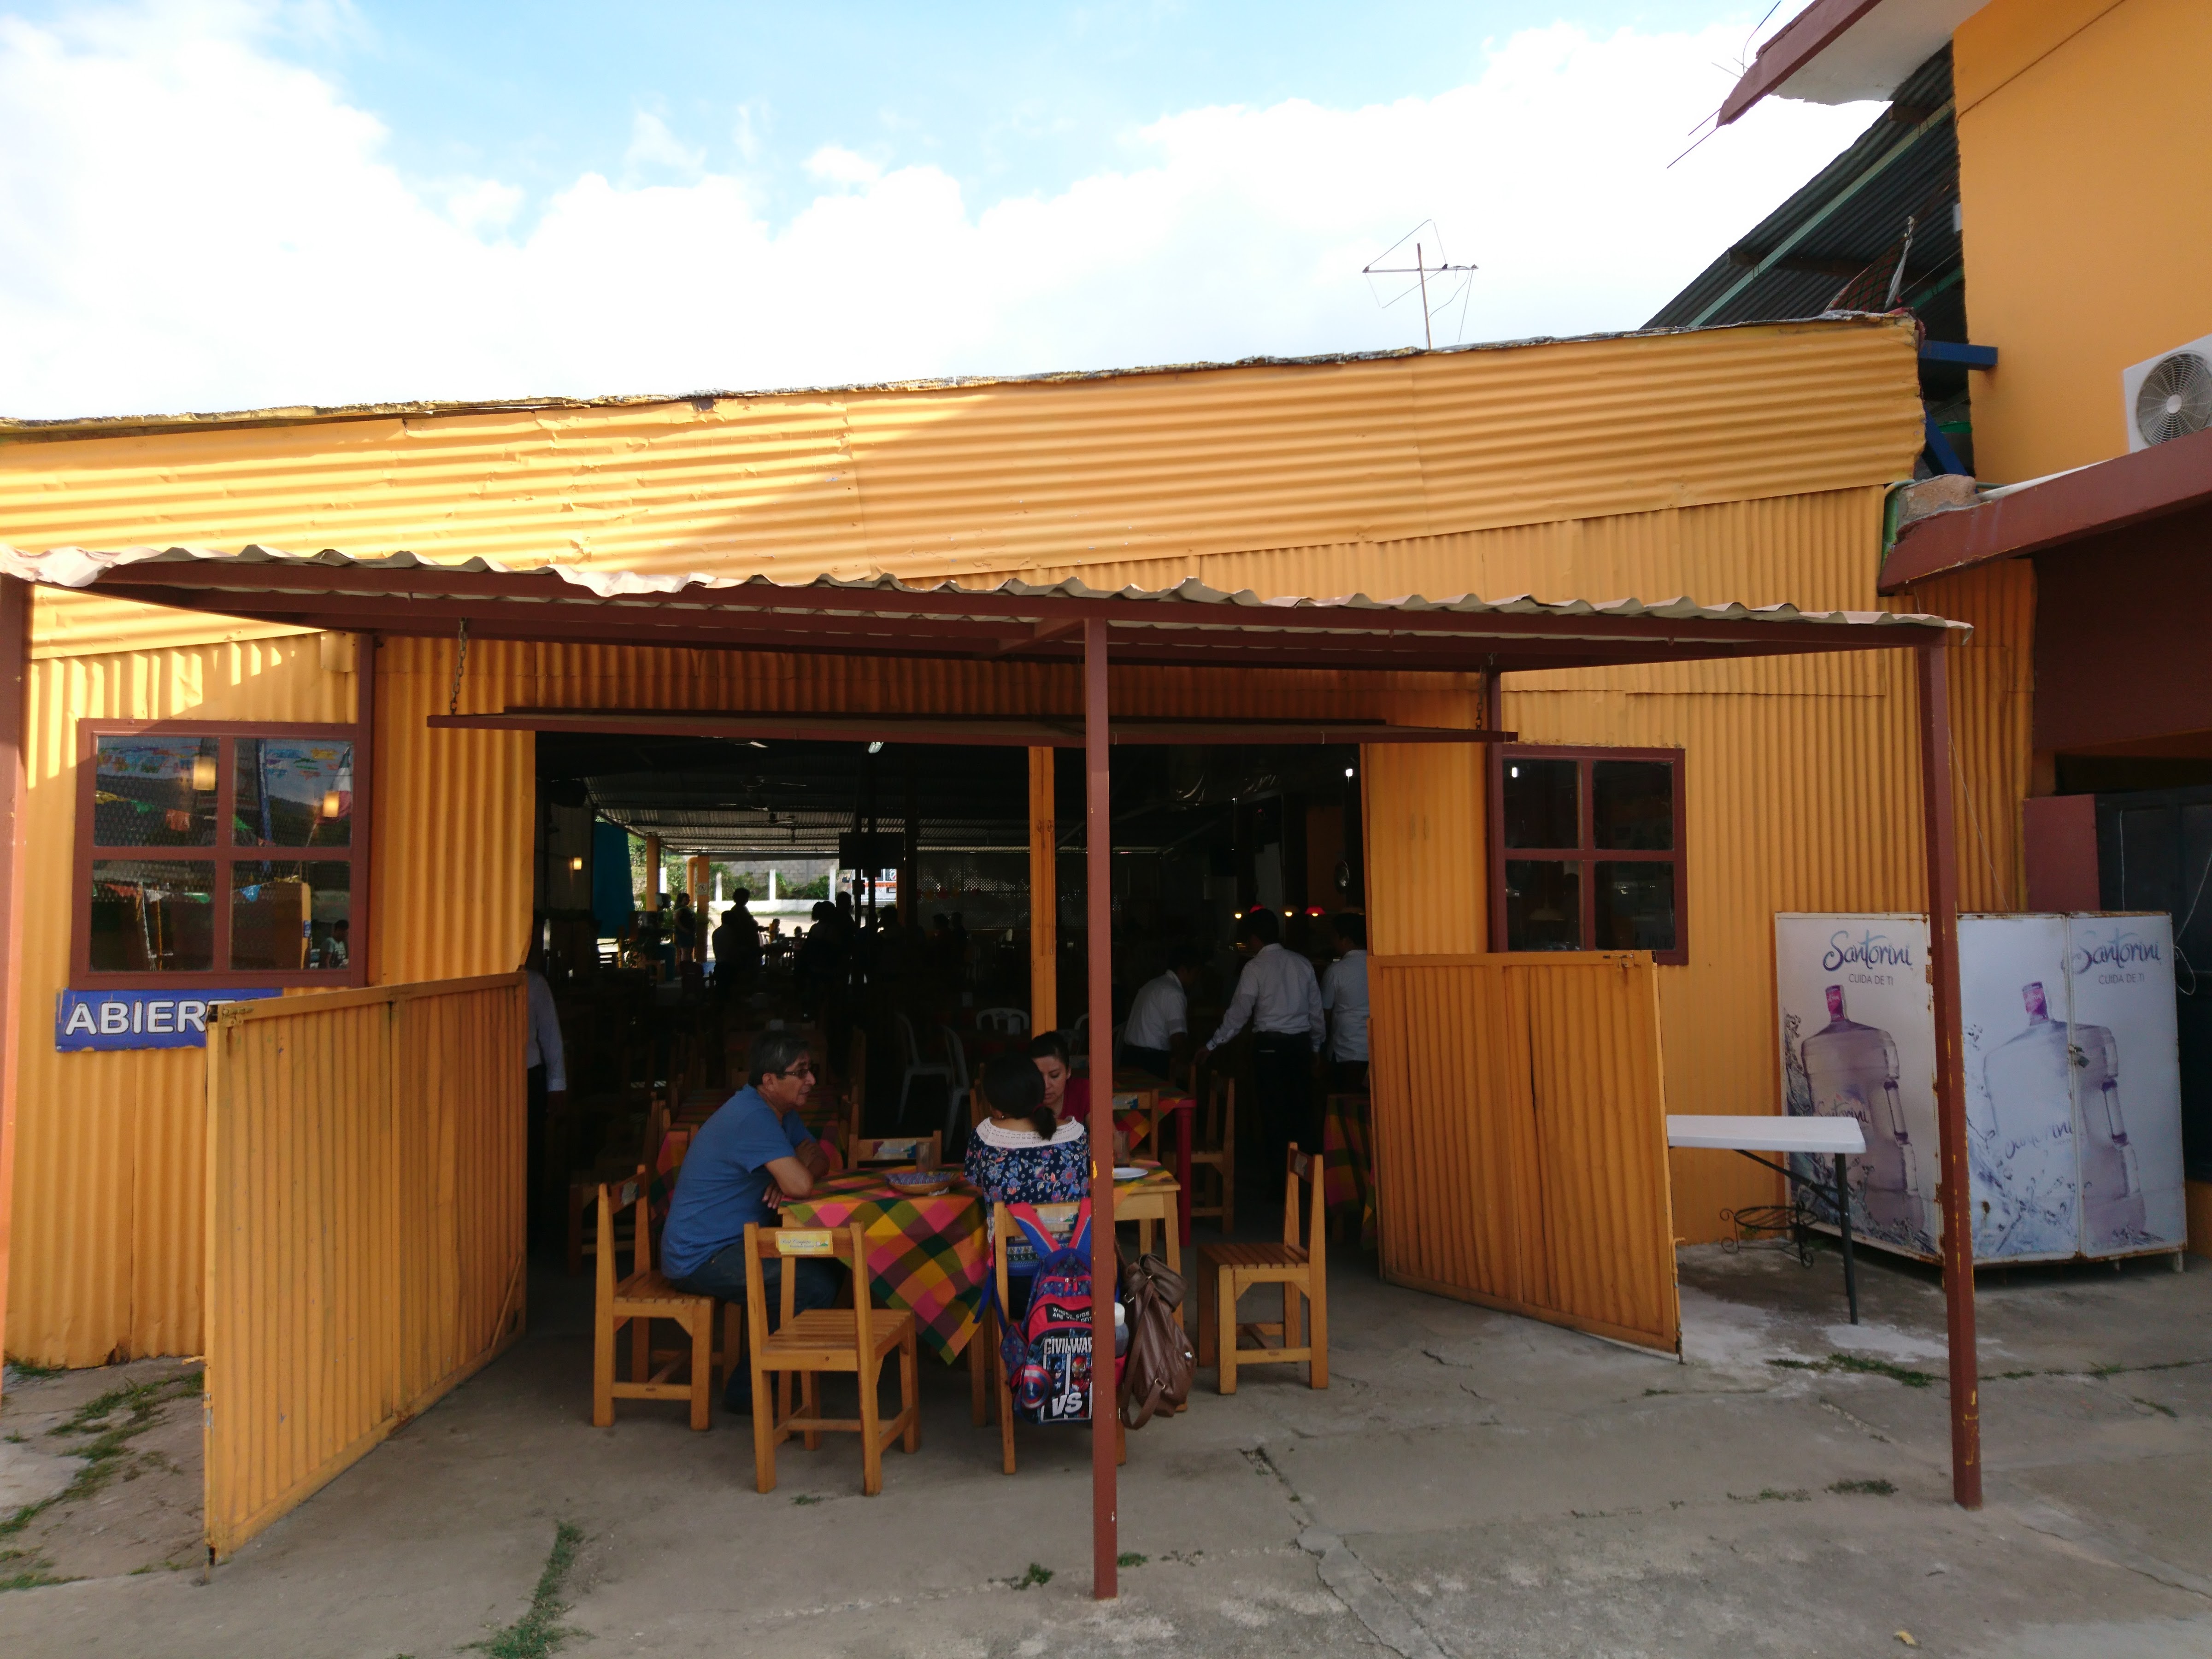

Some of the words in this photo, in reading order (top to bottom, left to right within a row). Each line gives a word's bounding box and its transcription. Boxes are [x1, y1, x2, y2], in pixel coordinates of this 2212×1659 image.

[1823, 930, 1912, 971] Santorini
[2061, 928, 2161, 974] Santorini
[1849, 974, 1872, 984] CUIDA
[1875, 976, 1884, 985] DE
[1887, 976, 1893, 985] TI
[2099, 975, 2124, 984] CUIDA
[2126, 974, 2136, 983] DE
[2138, 973, 2145, 982] TI
[65, 1000, 244, 1035] ABIER
[1044, 1338, 1070, 1354] CIVIL
[1052, 1392, 1082, 1417] VS
